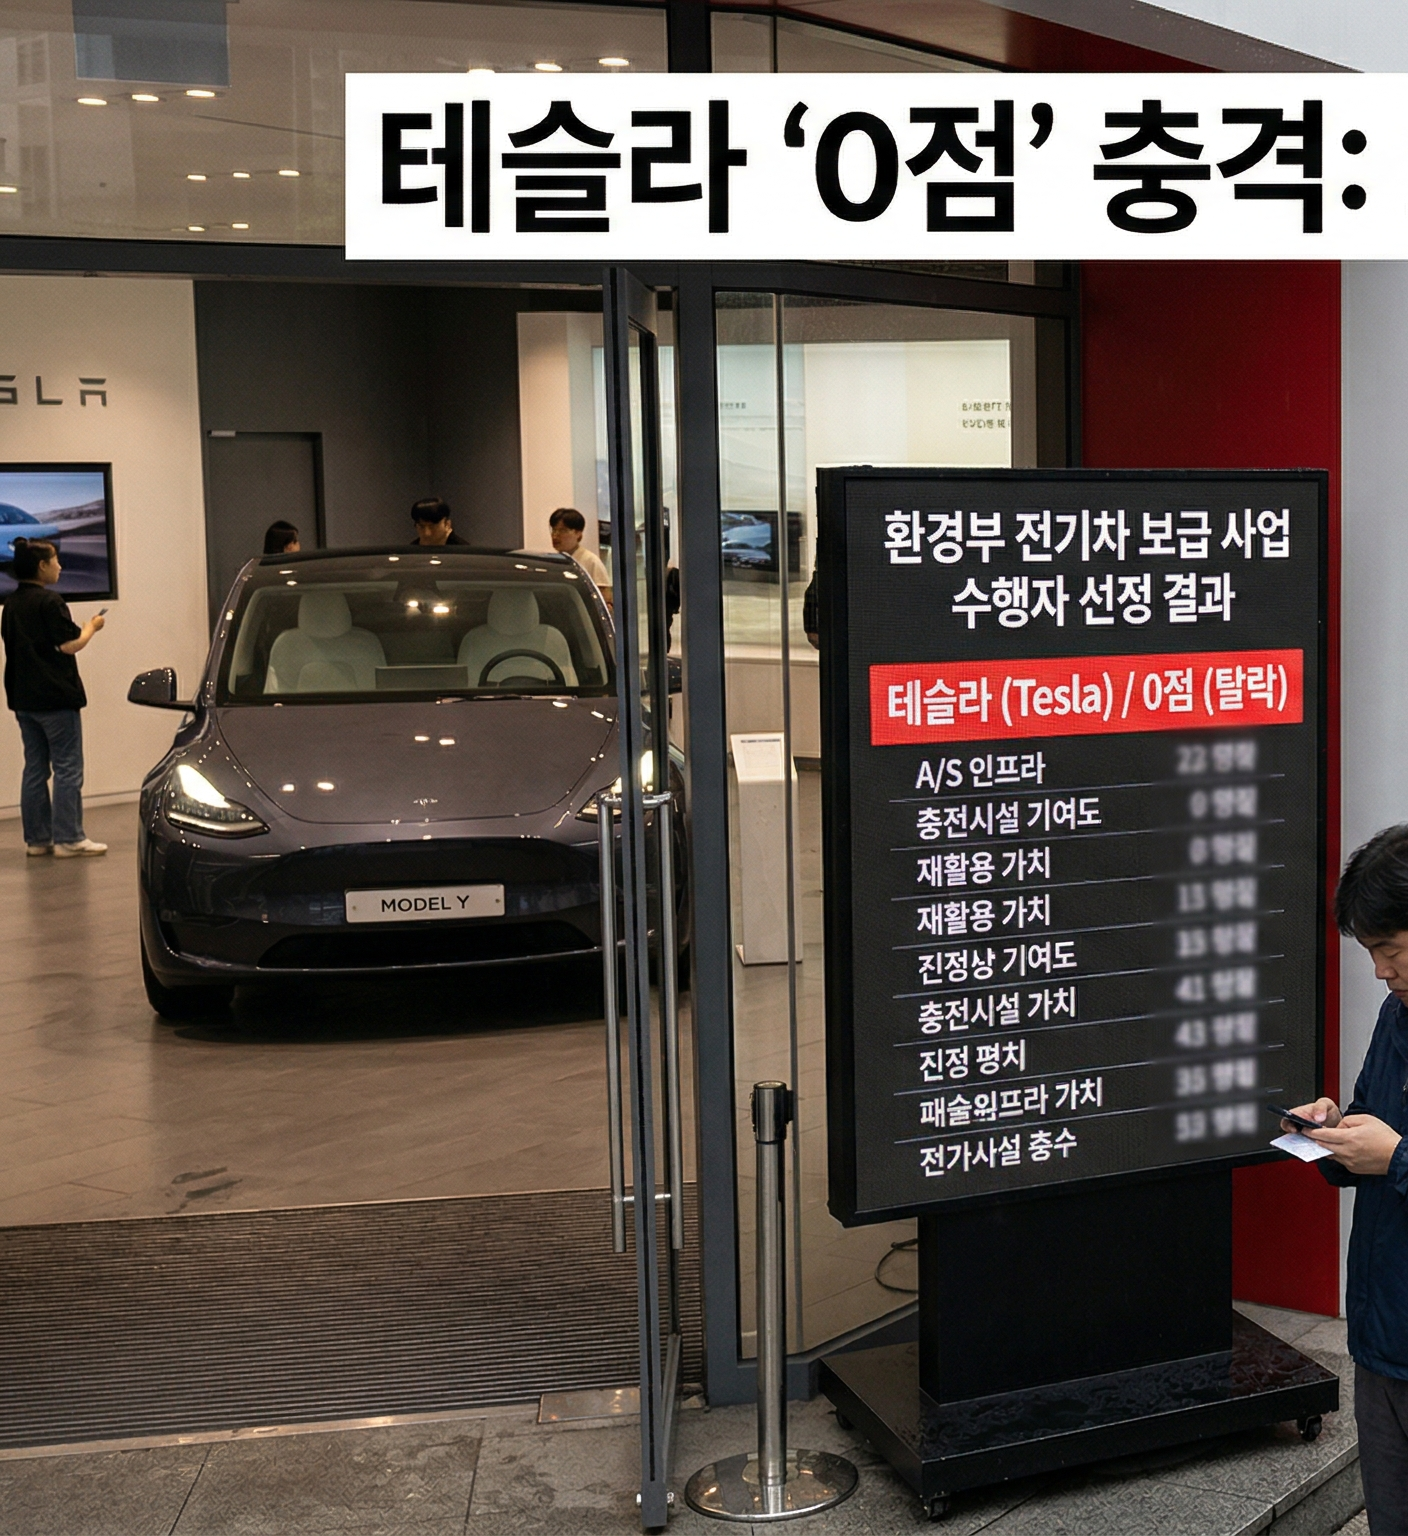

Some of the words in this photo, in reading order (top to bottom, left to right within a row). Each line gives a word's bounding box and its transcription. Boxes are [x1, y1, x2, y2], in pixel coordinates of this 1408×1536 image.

[885, 510, 1006, 565] 환경부
[1015, 509, 1132, 563] 전기차
[1139, 511, 1212, 560] 보급
[1221, 508, 1291, 560] 사업
[951, 575, 1070, 630] 수행자
[1079, 573, 1153, 626] 선정
[1163, 572, 1237, 624] 결과
[888, 677, 993, 727] 테슬라
[1001, 672, 1113, 728] (Tesla)
[1143, 667, 1194, 713] 0점
[1204, 664, 1288, 717] (탈락)
[916, 758, 963, 794] A/S
[970, 752, 1047, 788] 인프라
[917, 802, 1020, 840] 충전시설
[1027, 798, 1102, 833] 기여도
[917, 852, 996, 887] 재활용
[1002, 847, 1051, 882] 가치
[381, 897, 451, 913] MODEL
[456, 895, 470, 909] Y
[917, 900, 996, 936] 재활용
[1002, 894, 1051, 929] 가치
[918, 948, 996, 986] 진정상
[1003, 941, 1078, 977] 기여도
[918, 993, 1020, 1034] 충전시설
[1027, 986, 1076, 1021] 가치
[919, 1046, 969, 1083] 진정
[975, 1038, 1026, 1074] 평치
[1055, 1076, 1103, 1111] 가치
[920, 1133, 1022, 1178] 전가사설
[1028, 1127, 1079, 1163] 충수
